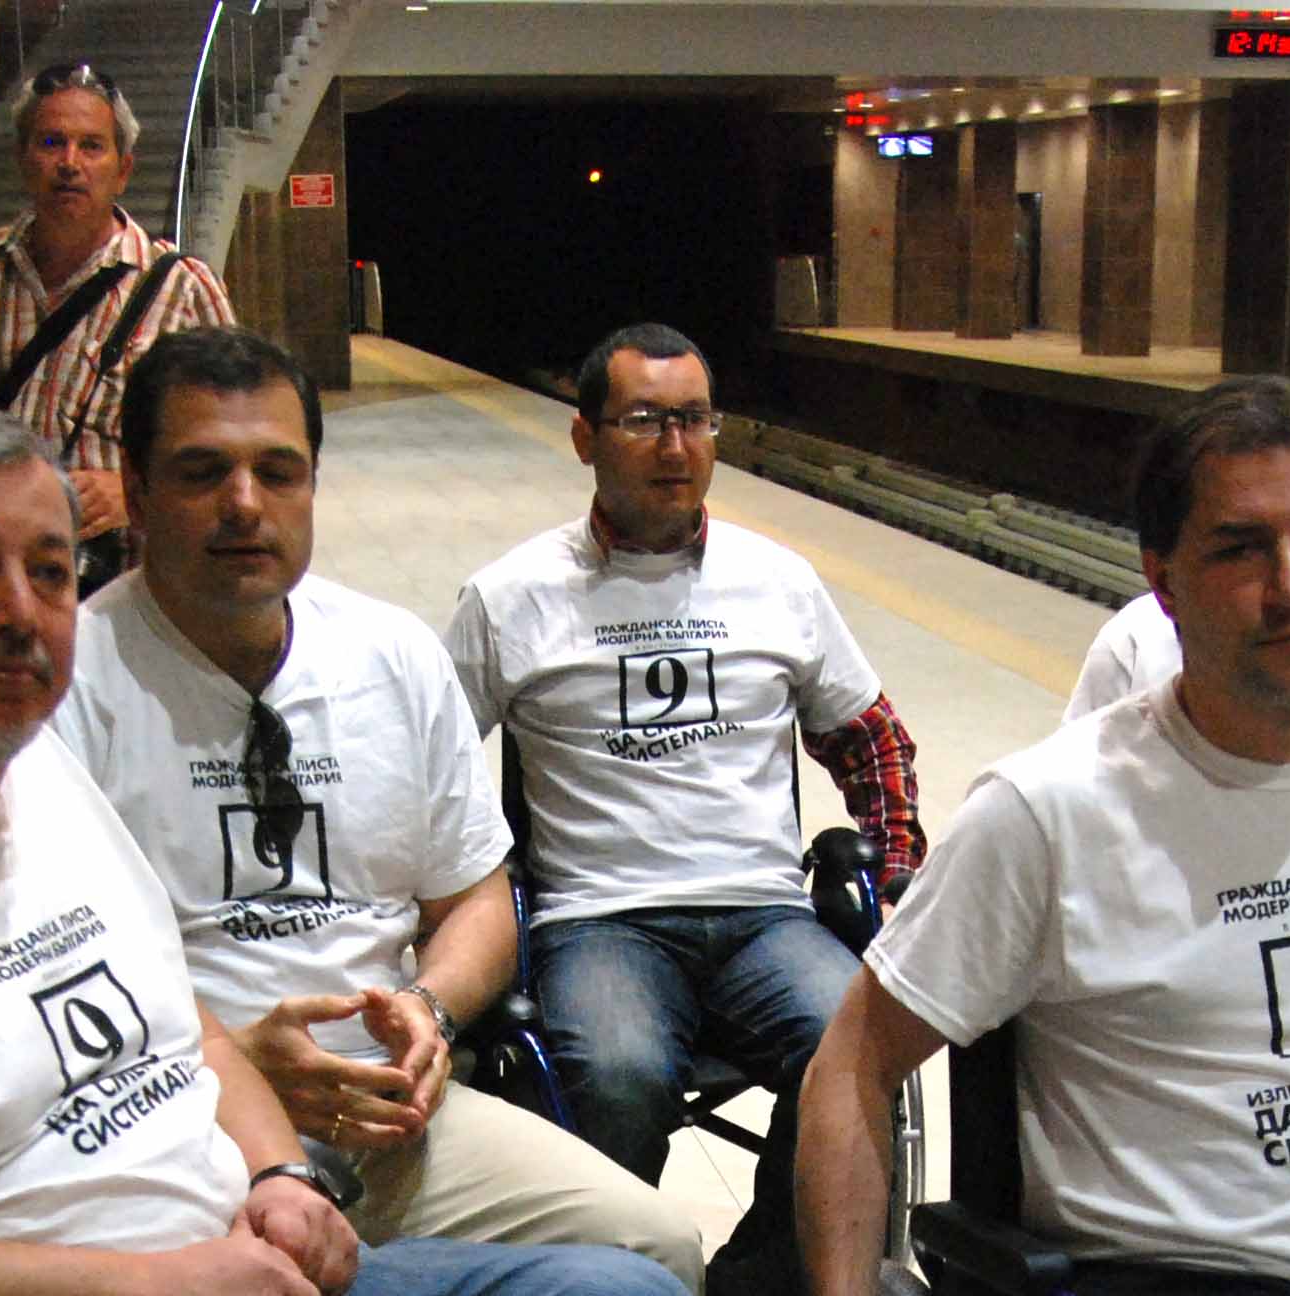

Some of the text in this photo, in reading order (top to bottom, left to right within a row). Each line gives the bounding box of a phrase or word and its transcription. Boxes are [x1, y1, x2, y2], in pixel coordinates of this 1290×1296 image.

[595, 619, 683, 636] ГРАЖДАНСКА
[596, 630, 662, 646] МОДЕРНА
[645, 657, 688, 721] 9
[296, 757, 341, 772] ЛИСТА
